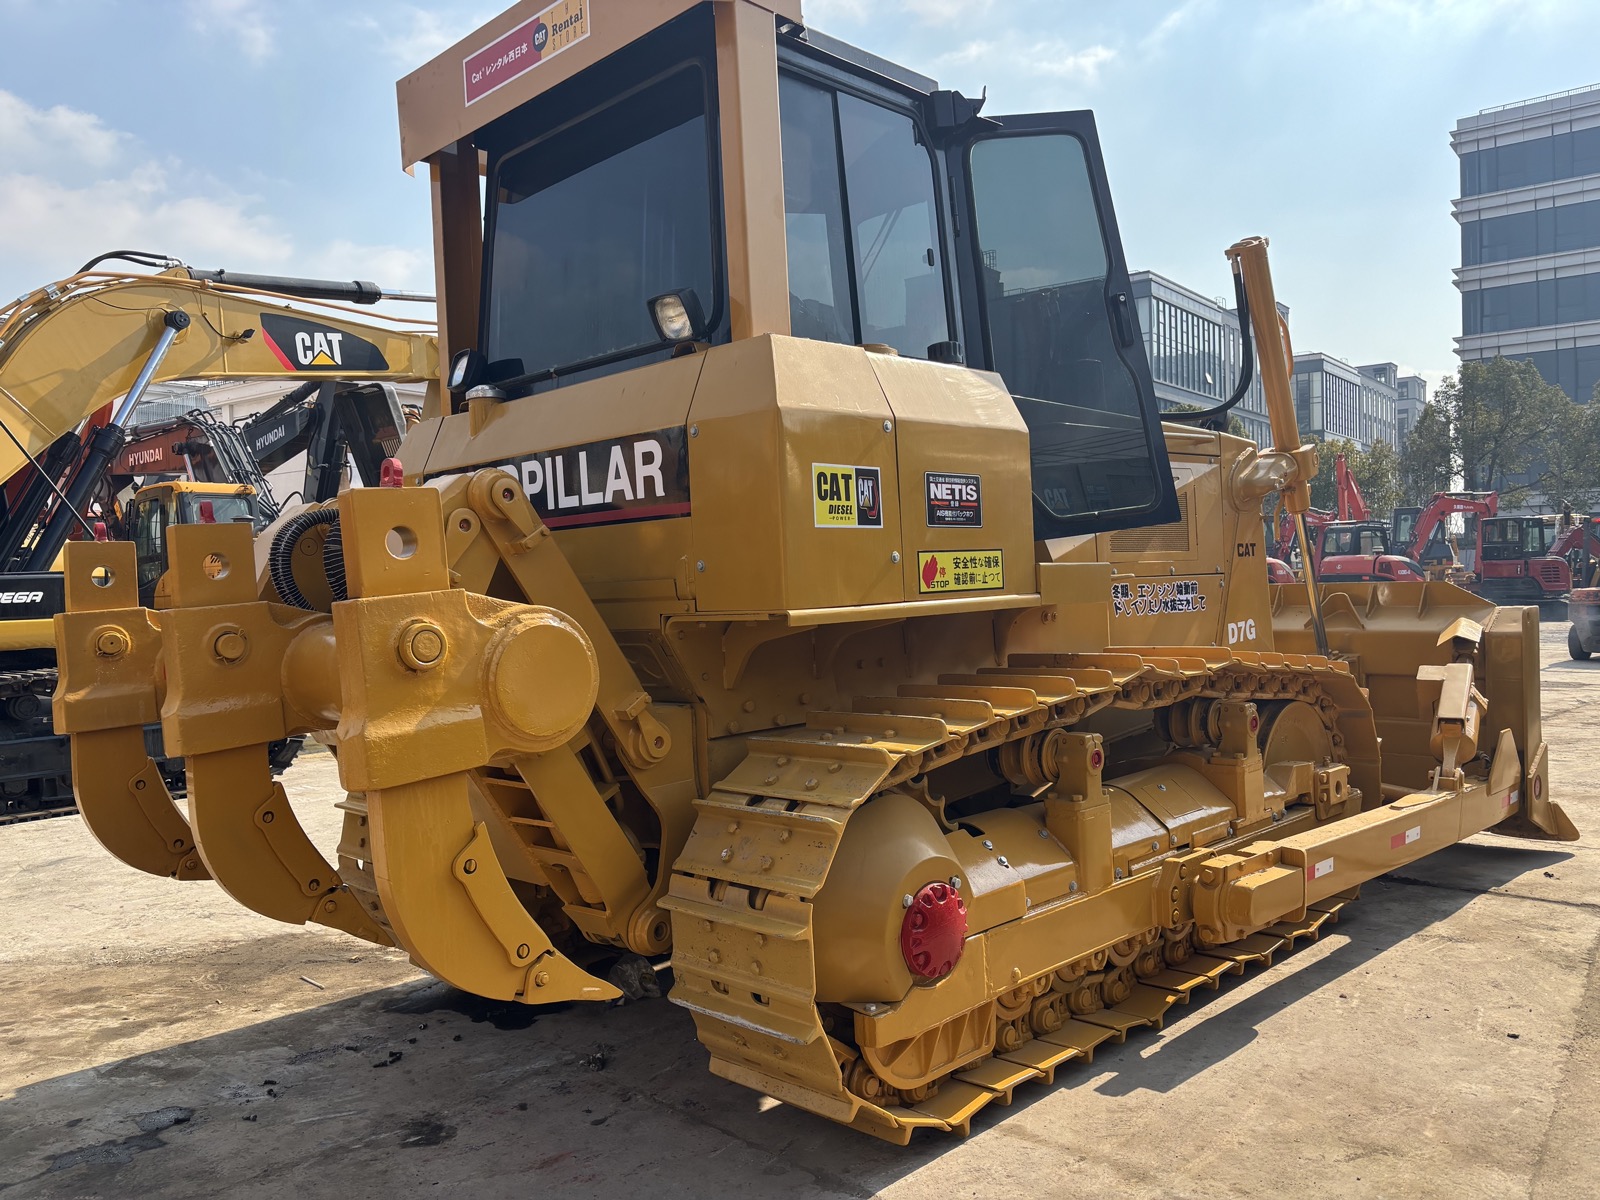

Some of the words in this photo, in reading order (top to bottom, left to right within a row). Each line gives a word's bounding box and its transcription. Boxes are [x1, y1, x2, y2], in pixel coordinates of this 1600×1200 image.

[552, 7, 583, 36] Rental
[534, 29, 546, 45] CAT
[553, 21, 584, 50] STORE
[485, 42, 527, 76] レンタル西日本
[295, 331, 342, 365] CAT
[256, 424, 285, 451] HYUNDAI
[128, 447, 163, 467] HYUNDAI
[817, 471, 852, 502] CAT
[858, 478, 873, 507] CAT
[930, 482, 978, 501] NETIS
[828, 504, 853, 515] DIESEL
[953, 555, 1000, 570] 安全性な確保
[1237, 542, 1256, 558] CAT
[930, 580, 950, 589] STOP
[1227, 618, 1257, 645] D7G
